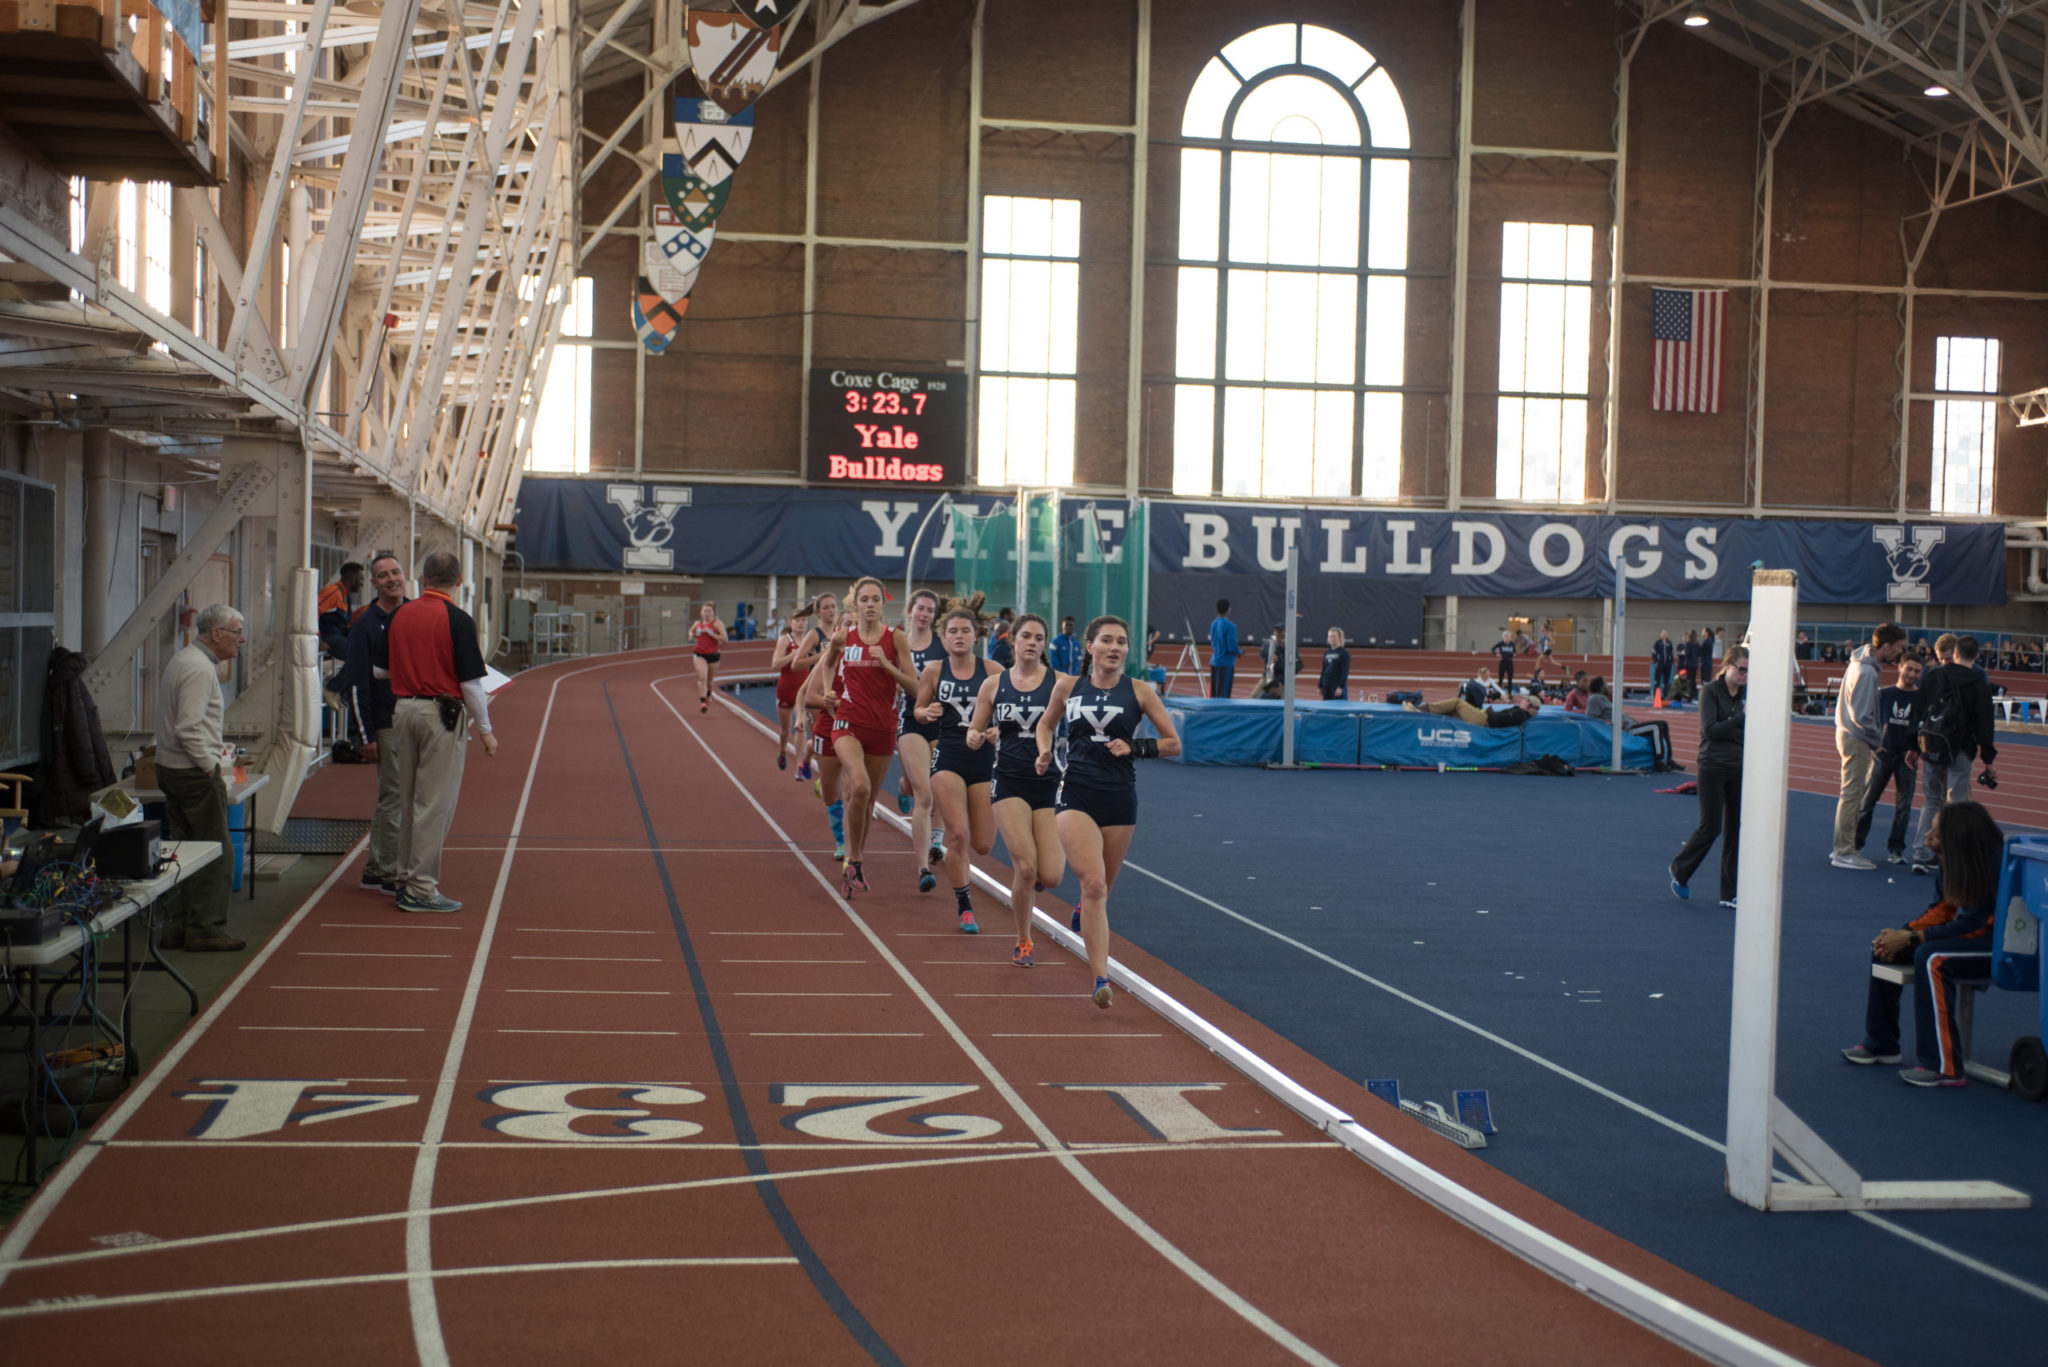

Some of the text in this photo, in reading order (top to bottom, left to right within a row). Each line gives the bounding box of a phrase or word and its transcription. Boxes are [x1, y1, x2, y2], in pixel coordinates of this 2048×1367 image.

[830, 371, 873, 388] Coxe
[877, 372, 919, 393] Cage
[845, 391, 927, 415] 3:23.7
[854, 424, 919, 449] Yale
[828, 455, 944, 482] Bulldogs
[861, 500, 1719, 581] YALE BULLDOGS
[846, 647, 860, 661] 10
[940, 684, 952, 701] 9
[950, 696, 978, 727] Y
[997, 704, 1012, 720] 12
[1014, 705, 1046, 738] Y
[1079, 705, 1124, 742] Y
[1417, 727, 1472, 744] UCS
[176, 1079, 419, 1140] 4
[482, 1082, 707, 1142] 3
[776, 1083, 1003, 1143] 2
[1058, 1083, 1284, 1142] 1
